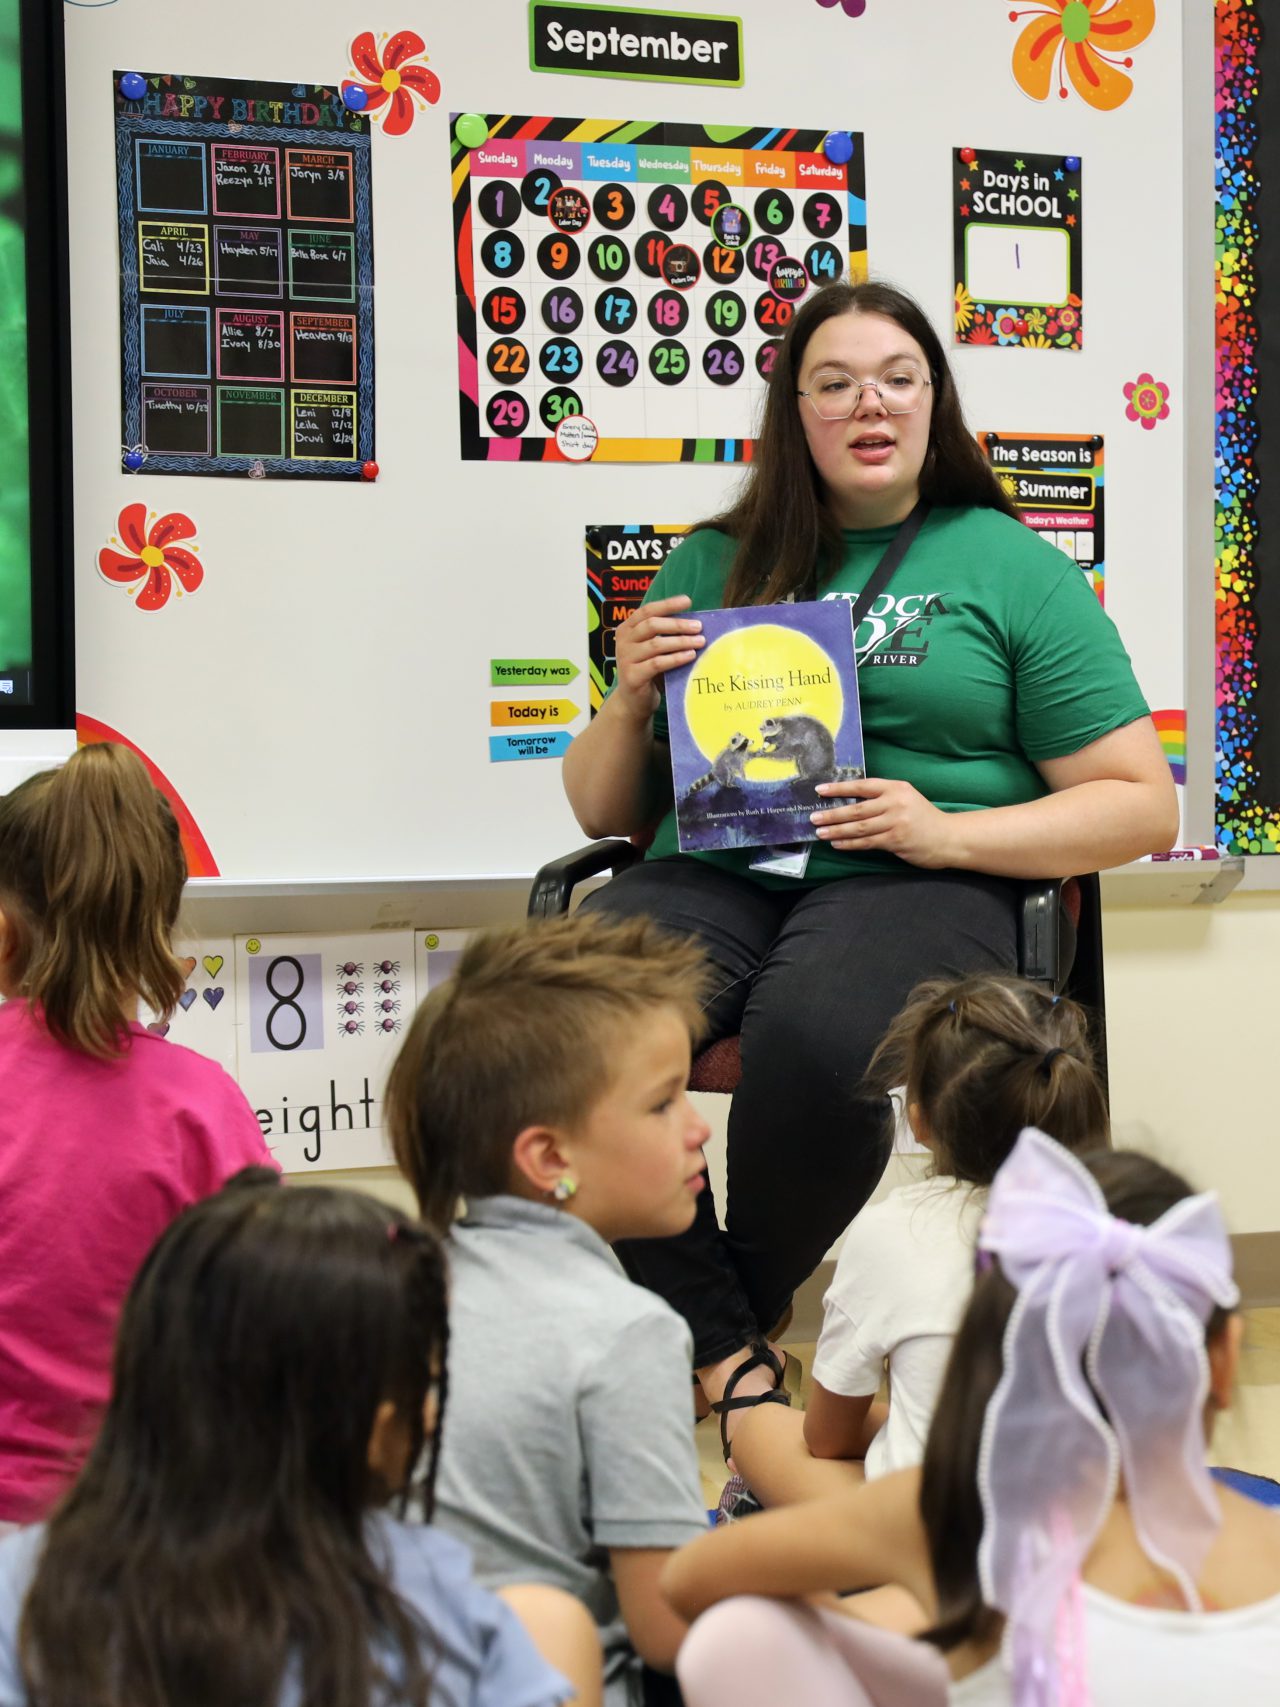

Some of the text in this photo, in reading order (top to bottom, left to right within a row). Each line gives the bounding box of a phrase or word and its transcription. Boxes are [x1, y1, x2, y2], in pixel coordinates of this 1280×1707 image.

[546, 21, 729, 65] September
[143, 93, 345, 127] HAPPY BIRTHDAY
[148, 144, 190, 155] JANUARY
[222, 150, 269, 160] FEBRUARY
[302, 155, 335, 164] MARCH
[254, 163, 271, 175] 2/8
[477, 151, 843, 181] Sunday Monday Tuesday Wednesday Thursday Friday Saturday
[328, 170, 345, 180] 3/8
[983, 169, 1049, 193] Days in
[495, 177, 831, 230] 1 2 3 4 5 6 7
[972, 191, 1062, 219] SCHOOL
[160, 228, 188, 237] APRIL
[240, 231, 259, 240] MAY
[309, 234, 331, 244] JUNE
[143, 239, 203, 254] Cali 4/23
[220, 243, 258, 258] Hayden
[494, 239, 835, 277] 8 9 10 11 12 13 14
[164, 309, 185, 320] JULY
[491, 295, 791, 327] 15 16 17 18 19 20
[232, 314, 269, 324] AUGUST
[296, 316, 350, 327] SEPTEMBER
[296, 330, 335, 341] Heaven
[493, 345, 525, 373] 22
[545, 345, 579, 373] 23
[603, 348, 635, 377] 24
[655, 348, 685, 375] 25
[708, 349, 739, 375] 26
[153, 388, 197, 398] OCTOBER
[226, 390, 277, 400] NOVEMBER
[300, 393, 348, 404] DECEMBER
[146, 401, 182, 414] Timothy
[296, 407, 351, 419] Leni 12/8
[493, 395, 579, 426] 29 30
[992, 446, 1091, 463] The Season is
[1019, 480, 1089, 499] Summer
[1025, 515, 1089, 526] Today's Weather
[607, 539, 663, 560] DAYS
[873, 655, 918, 665] RIVER
[495, 666, 570, 678] Yesterday was
[693, 667, 832, 695] The Kissing Hand
[723, 697, 802, 712] by AUDREY PENN
[508, 706, 559, 722] Today is
[507, 736, 556, 747] Tomorrow
[518, 746, 548, 756] will be
[266, 955, 307, 1051] 8
[256, 1077, 374, 1162] eight
